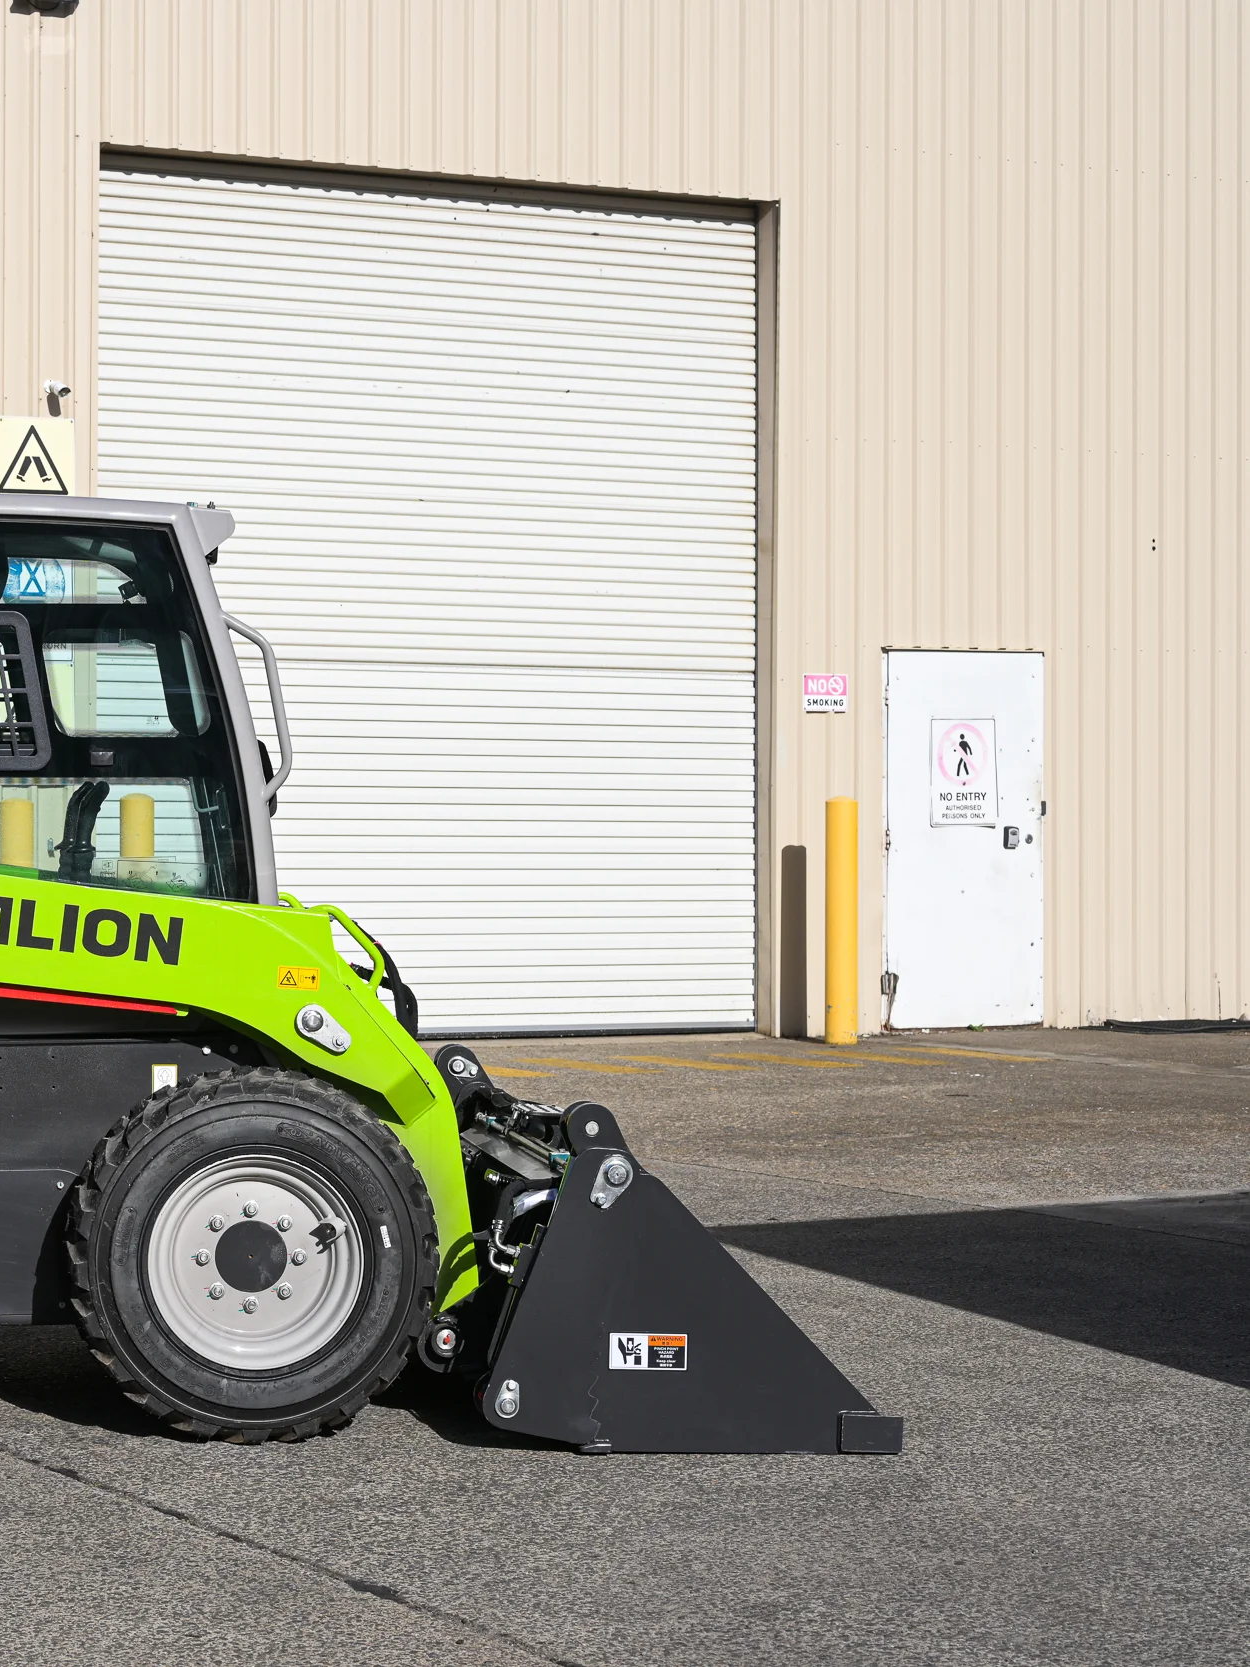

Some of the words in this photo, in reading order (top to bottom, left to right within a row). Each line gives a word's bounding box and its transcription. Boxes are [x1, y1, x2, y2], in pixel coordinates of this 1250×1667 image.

[807, 678, 827, 693] NO
[806, 698, 844, 707] SMOKING
[939, 792, 953, 801] NO
[956, 792, 987, 801] ENTRY
